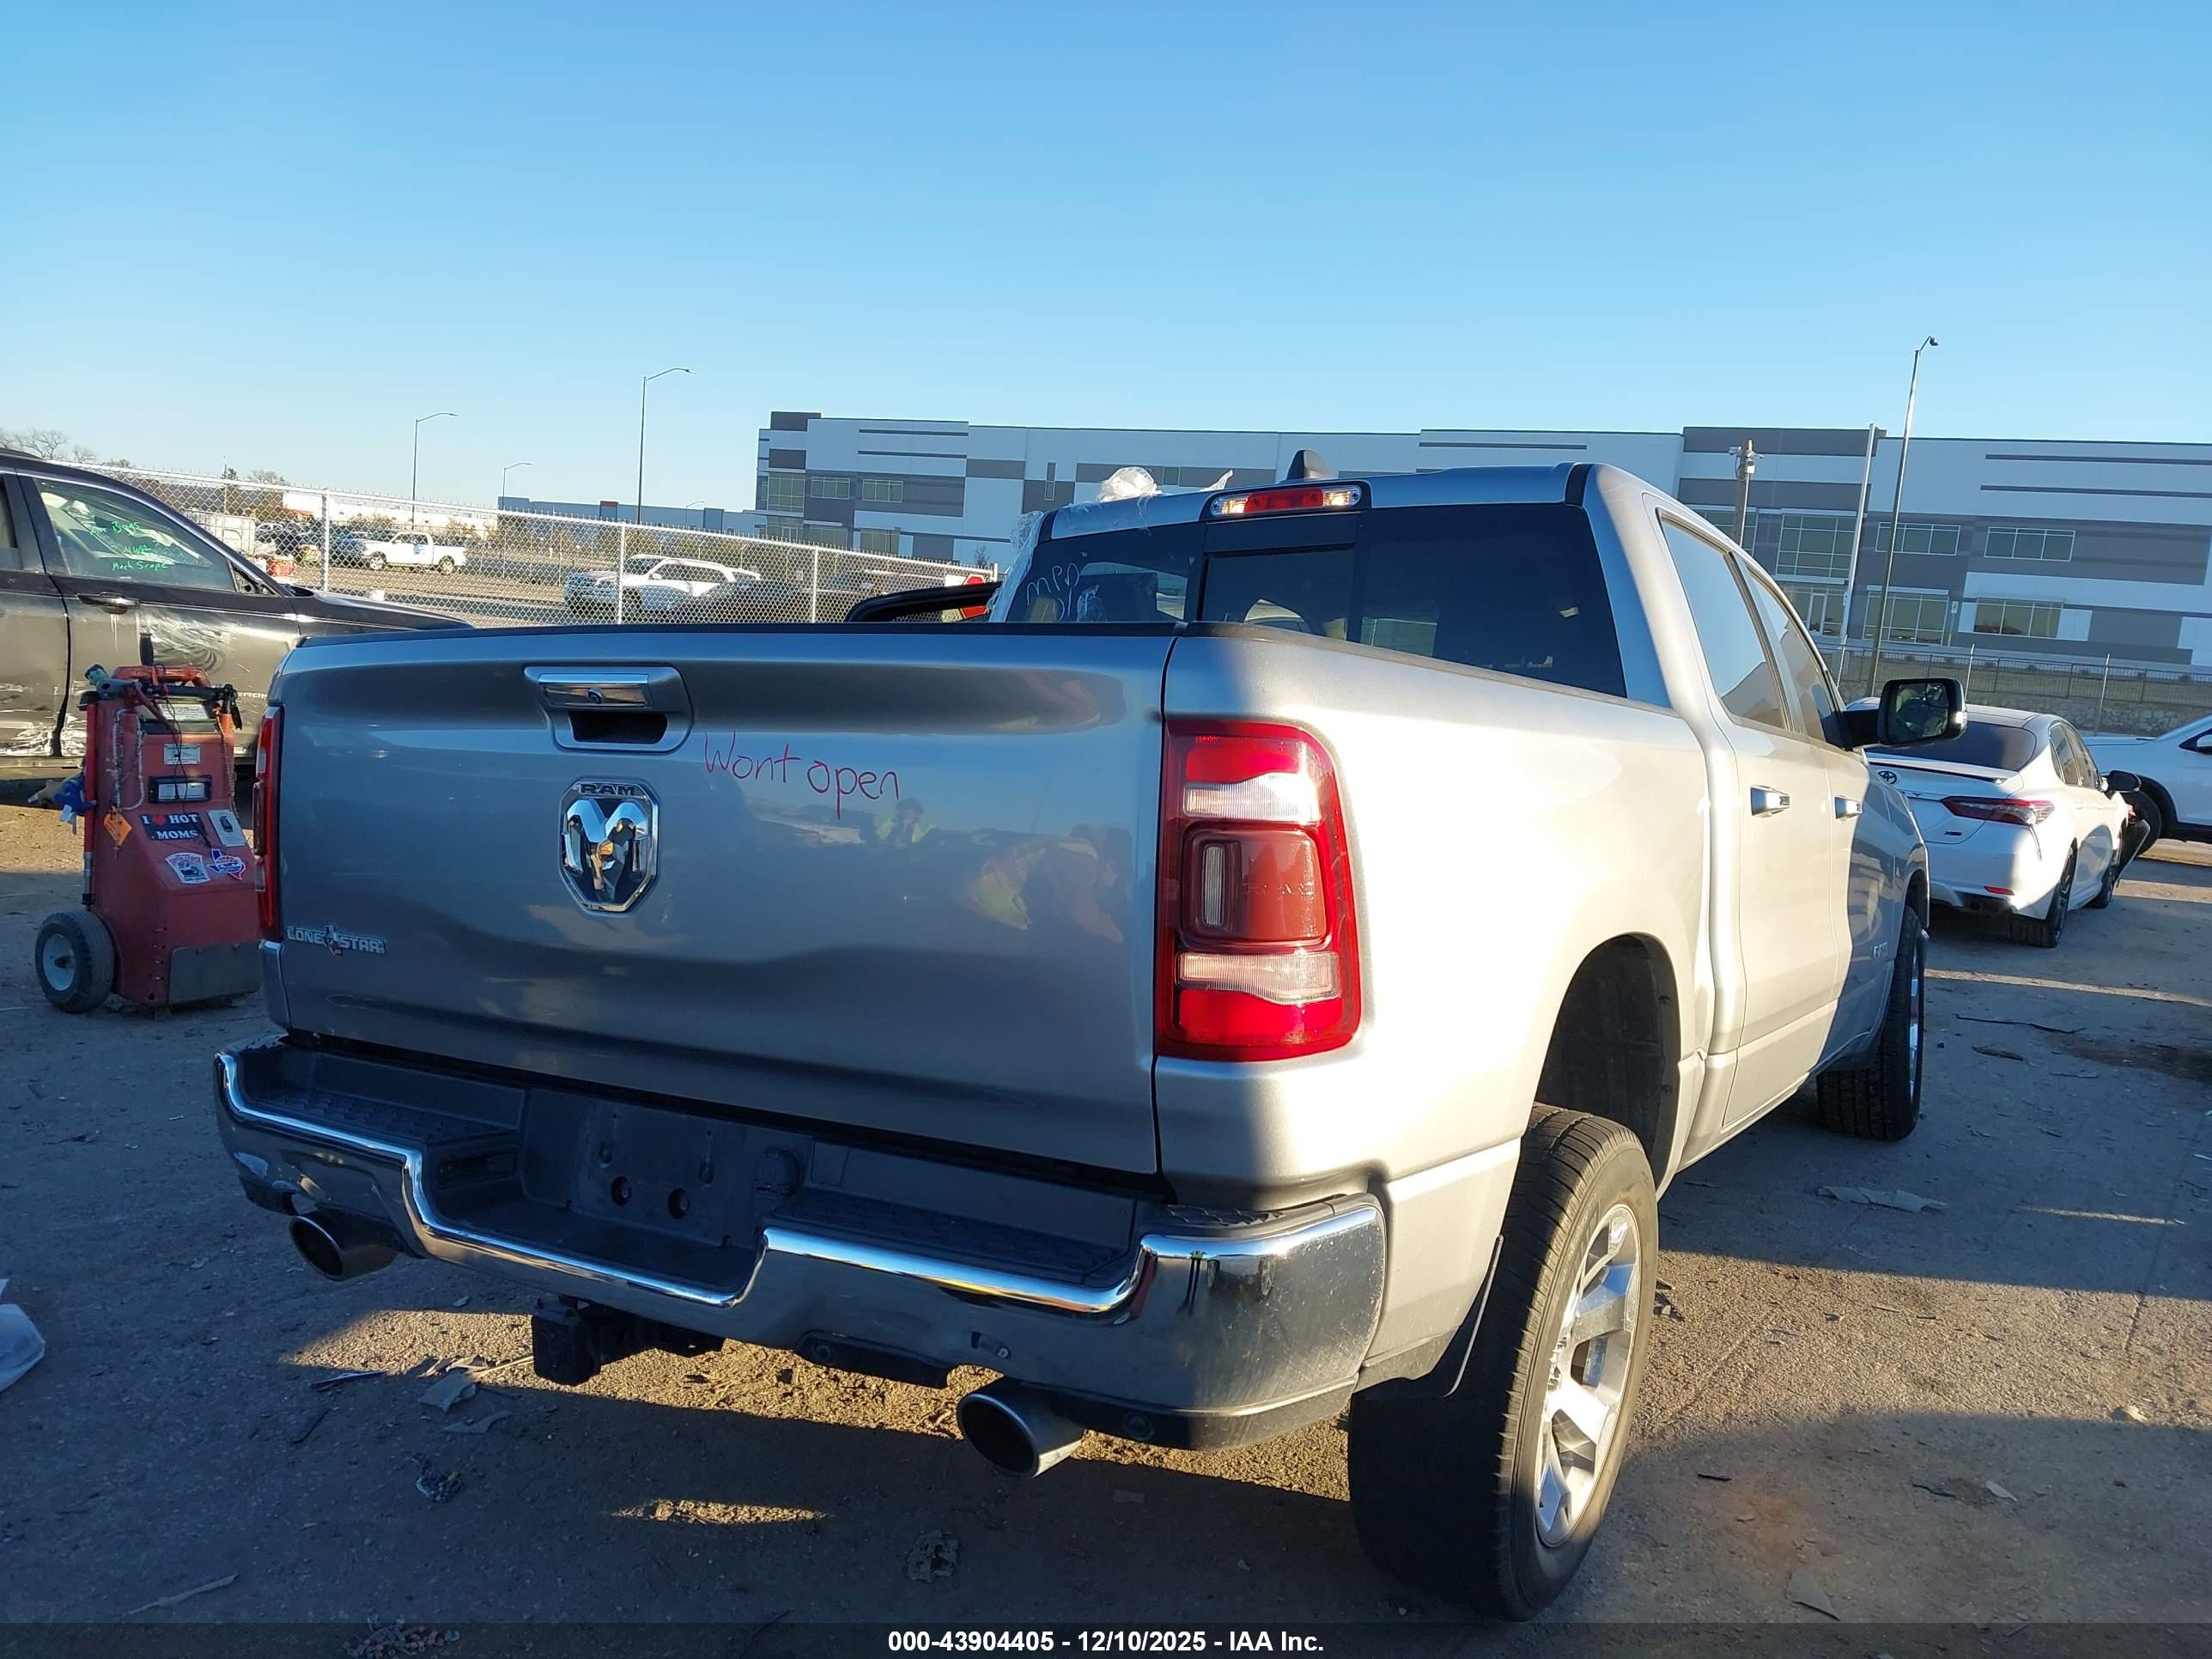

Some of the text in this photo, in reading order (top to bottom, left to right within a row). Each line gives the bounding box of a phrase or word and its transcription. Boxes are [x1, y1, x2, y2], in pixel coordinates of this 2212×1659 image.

[703, 729, 900, 821] Wont open
[579, 783, 636, 797] RAM
[142, 814, 198, 824] I HOT
[155, 830, 199, 840] MOMS
[286, 926, 386, 954] LONE STAR
